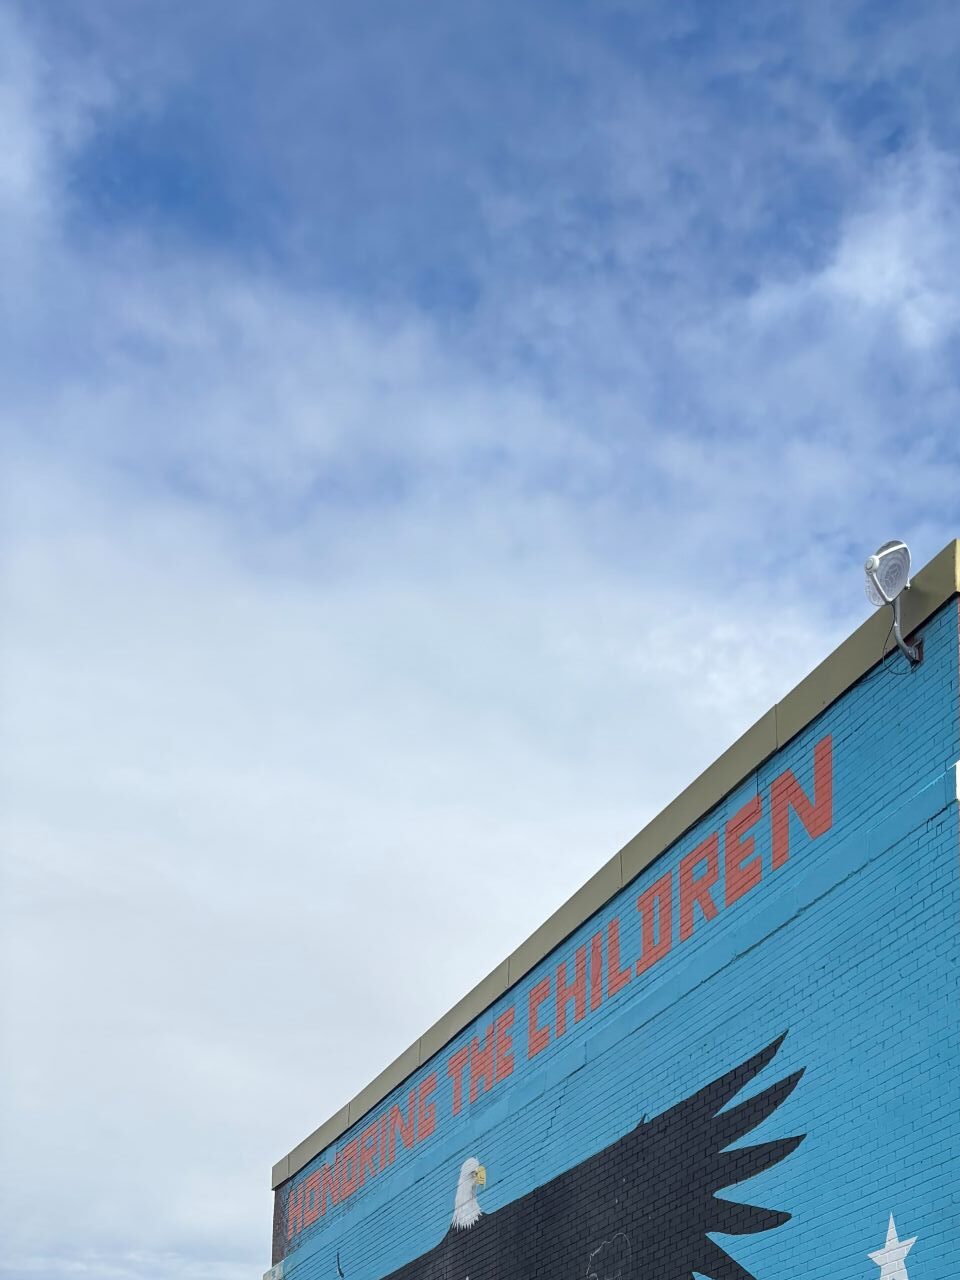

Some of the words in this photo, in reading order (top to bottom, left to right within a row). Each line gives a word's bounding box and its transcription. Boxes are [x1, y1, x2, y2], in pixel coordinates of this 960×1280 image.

[287, 1071, 438, 1241] HONORING
[447, 1004, 515, 1117] THE
[527, 734, 834, 1060] CHILDREN
